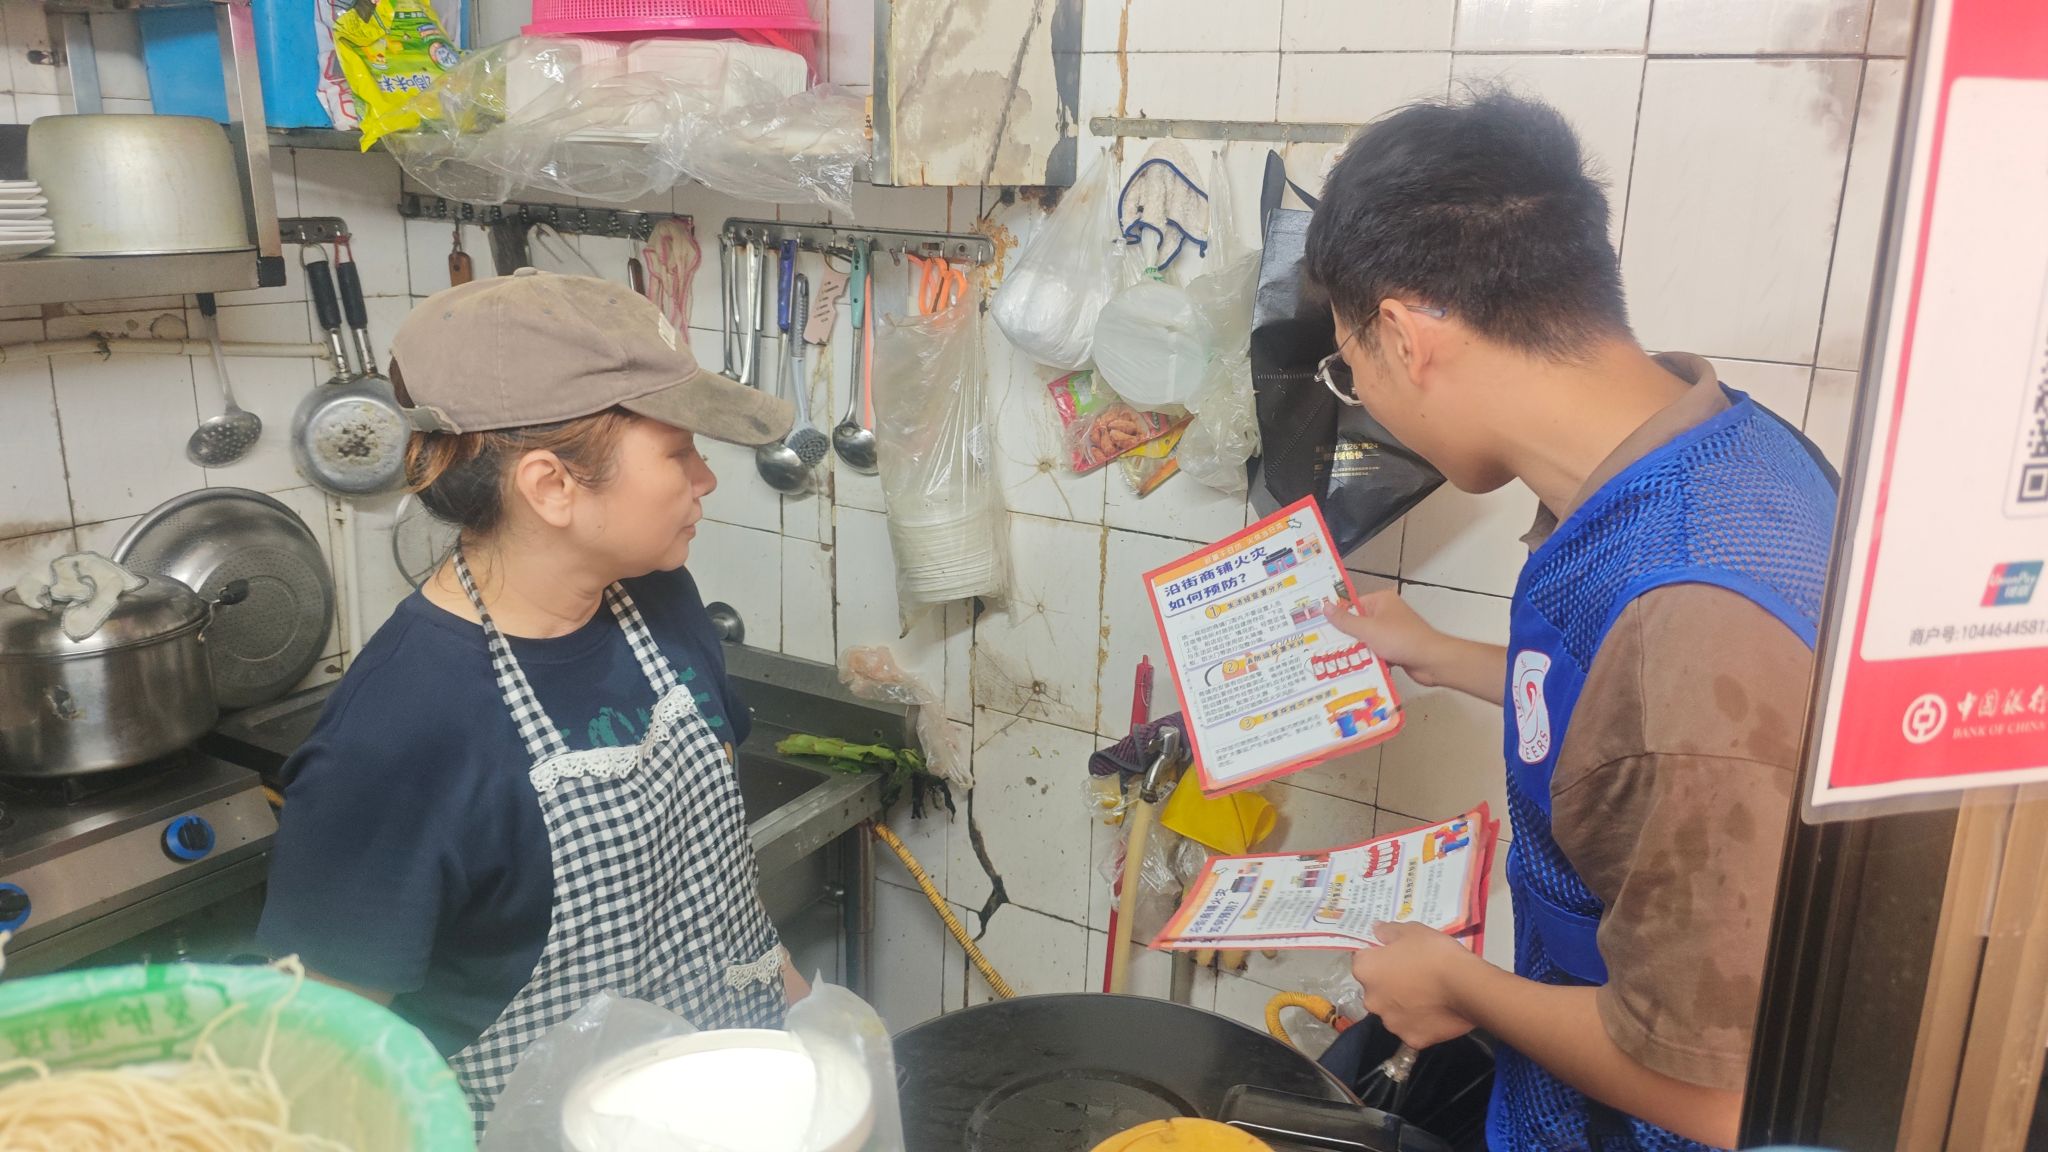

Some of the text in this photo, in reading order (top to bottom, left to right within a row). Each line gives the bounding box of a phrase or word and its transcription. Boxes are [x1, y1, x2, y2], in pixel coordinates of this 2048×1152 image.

[1164, 546, 1267, 597] 沿街商铺火灾
[1168, 573, 1246, 611] 如何预防?
[1909, 619, 2048, 647] 商户号:1044644581
[1952, 721, 2046, 739] BANK OF CHINA
